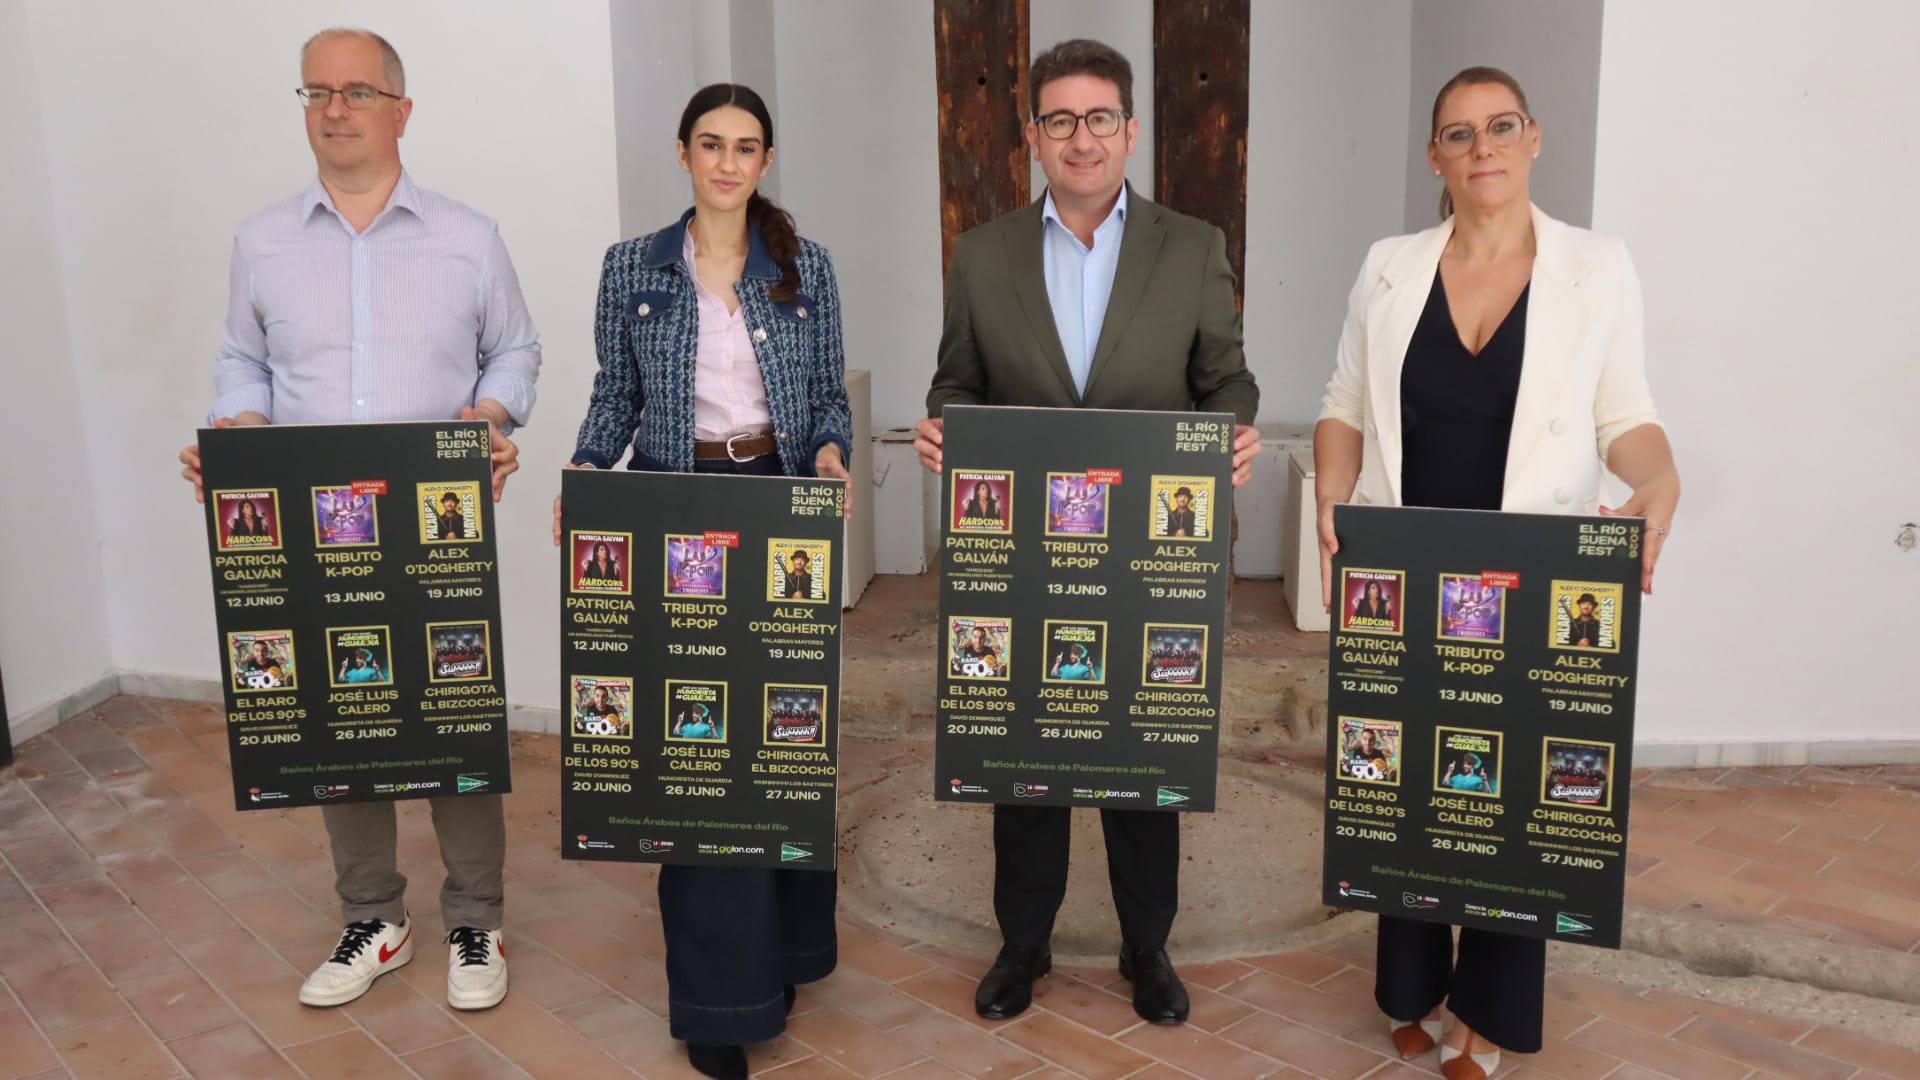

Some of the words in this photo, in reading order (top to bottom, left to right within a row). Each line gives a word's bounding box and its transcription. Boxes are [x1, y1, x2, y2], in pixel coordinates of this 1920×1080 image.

[1176, 422, 1193, 431] EL
[1195, 420, 1218, 431] RÍO
[435, 431, 452, 439] EL
[453, 427, 477, 438] RÍO
[1176, 432, 1219, 442] SUENA
[436, 439, 478, 448] SUENA
[1175, 441, 1207, 451] FEST
[436, 449, 468, 458] FEST
[791, 486, 808, 495] EL
[810, 484, 833, 496] RÍO
[791, 496, 834, 506] SUENA
[791, 505, 822, 515] FEST
[1580, 524, 1598, 534] EL
[1600, 522, 1627, 535] RÍO
[946, 537, 1016, 550] PATRICIA
[1579, 534, 1628, 546] SUENA
[427, 547, 469, 559] ALEX
[1042, 541, 1108, 554] TRIBUTO
[1154, 545, 1197, 557] ALEX
[1578, 545, 1614, 556] FEST
[215, 553, 288, 566] PATRICIA
[314, 550, 382, 563] TRIBUTO
[952, 549, 1008, 564] GALVÁN
[1051, 556, 1098, 568] K-POP
[223, 565, 281, 580] GALVÁN
[325, 565, 374, 577] K-POP
[951, 580, 966, 590] 12
[968, 581, 1007, 592] JUNIO
[1047, 583, 1063, 594] 13
[1064, 584, 1107, 595] JUNIO
[324, 593, 341, 603] 13
[342, 591, 385, 602] JUNIO
[427, 589, 442, 598] 19
[443, 587, 483, 597] JUNIO
[1149, 587, 1164, 597] 19
[1166, 588, 1206, 599] JUNIO
[226, 597, 242, 607] 12
[243, 596, 284, 606] JUNIO
[566, 597, 635, 610] PATRICIA
[661, 602, 727, 615] TRIBUTO
[773, 607, 814, 619] ALEX
[573, 609, 628, 624] GALVÁN
[671, 617, 718, 629] K-POP
[572, 640, 587, 650] 12
[589, 641, 628, 652] JUNIO
[1336, 635, 1407, 652] PATRICIA
[667, 644, 683, 654] 13
[685, 644, 726, 656] JUNIO
[768, 648, 783, 658] 19
[785, 649, 824, 660] JUNIO
[1434, 644, 1504, 661] TRIBUTO
[1342, 648, 1398, 666] GALVÁN
[1555, 654, 1602, 669] ALEX
[1443, 661, 1494, 676] K-POP
[424, 684, 497, 696] CHIRIGOTA
[949, 685, 966, 695] EL
[968, 686, 1007, 697] RARO
[1037, 685, 1074, 698] JOSÉ
[1076, 689, 1108, 700] LUIS
[1341, 680, 1356, 691] 12
[1358, 681, 1398, 695] JUNIO
[326, 689, 364, 702] JOSÉ
[366, 690, 398, 700] LUIS
[1135, 691, 1209, 703] CHIRIGOTA
[1439, 688, 1455, 700] 13
[1457, 690, 1502, 704] JUNIO
[236, 698, 254, 708] EL
[256, 696, 296, 707] RARO
[420, 701, 436, 709] EL
[437, 697, 504, 708] BIZCOCHO
[940, 699, 957, 709] DE
[960, 700, 984, 710] LOS
[1046, 701, 1099, 713] CALERO
[1549, 699, 1565, 710] 19
[1567, 700, 1612, 715] JUNIO
[337, 703, 390, 715] CALERO
[1129, 705, 1145, 714] EL
[1147, 706, 1215, 717] BIZCOCHO
[229, 712, 247, 722] DE
[249, 711, 274, 721] LOS
[335, 729, 354, 739] 26
[355, 727, 396, 738] JUNIO
[436, 724, 453, 734] 27
[454, 722, 492, 733] JUNIO
[947, 724, 966, 734] 20
[968, 725, 1007, 735] JUNIO
[1041, 727, 1060, 737] 26
[1061, 728, 1102, 739] JUNIO
[238, 735, 259, 745] 20
[260, 733, 301, 744] JUNIO
[1143, 732, 1159, 742] 27
[1161, 733, 1199, 743] JUNIO
[573, 743, 590, 753] EL
[592, 744, 630, 755] RARO
[660, 743, 696, 757] JOSÉ
[699, 748, 730, 758] LUIS
[565, 756, 581, 766] DE
[584, 757, 608, 767] LOS
[756, 749, 829, 762] CHIRIGOTA
[669, 759, 721, 771] CALERO
[751, 763, 766, 772] EL
[768, 764, 835, 775] BIZCOCHO
[394, 780, 440, 791] giglon.com
[572, 781, 590, 791] 20
[593, 782, 631, 792] JUNIO
[665, 785, 683, 794] 26
[685, 785, 725, 796] JUNIO
[765, 789, 781, 799] 27
[783, 790, 820, 801] JUNIO
[1093, 788, 1140, 800] giglon.com
[1338, 785, 1355, 797] EL
[1357, 788, 1397, 802] RARO
[1329, 799, 1346, 810] DE
[1349, 801, 1373, 814] LOS
[1428, 793, 1467, 810] JOSÉ
[1469, 801, 1504, 815] LUIS
[1437, 811, 1493, 828] CALERO
[1532, 808, 1615, 828] CHIRIGOTA
[1335, 825, 1354, 836] 20
[1357, 827, 1397, 842] JUNIO
[1526, 822, 1543, 833] EL
[1545, 825, 1622, 843] BIZCOCHO
[718, 844, 763, 855] giglon.com
[1432, 837, 1451, 849] 26
[1453, 840, 1497, 856] JUNIO
[1541, 852, 1559, 864] 27
[1561, 855, 1604, 870] JUNIO
[1487, 906, 1537, 924] giglon.com
